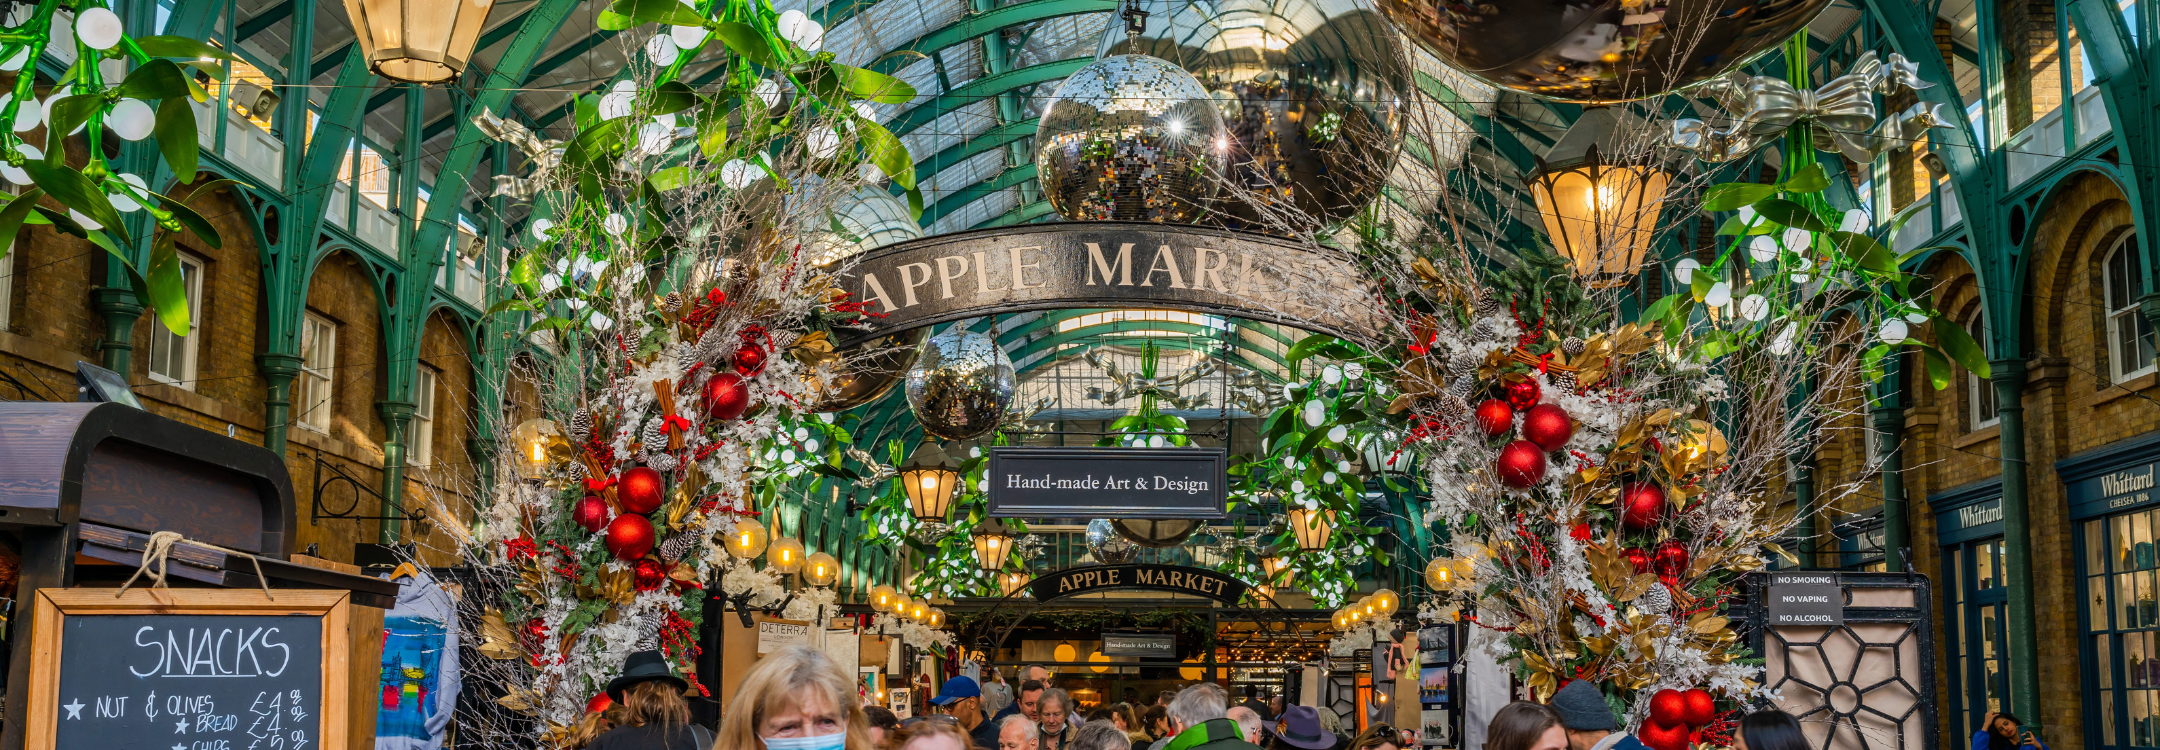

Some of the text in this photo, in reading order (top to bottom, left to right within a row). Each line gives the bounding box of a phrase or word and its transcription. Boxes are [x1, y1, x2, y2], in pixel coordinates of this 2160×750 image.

[860, 245, 1047, 320] APPLE
[1006, 473, 1209, 495] Hand-made Art & Design
[2101, 463, 2155, 498] Whittard
[2109, 492, 2149, 508] CHELSEA 1886
[1959, 498, 2003, 528] Whittard
[1058, 568, 1228, 596] APPLE MARKET
[1778, 576, 1831, 584] NO SMOKING
[1782, 595, 1828, 603] NO VAPING
[1779, 614, 1833, 622] NO ALCOHOL
[761, 623, 808, 635] DETERRA
[129, 625, 290, 678] SNACKS
[1106, 641, 1136, 649] Hand-made
[1152, 642, 1171, 650] Design
[96, 696, 129, 718] NUT
[167, 694, 214, 716] OLIVES
[196, 714, 238, 733] BREAD
